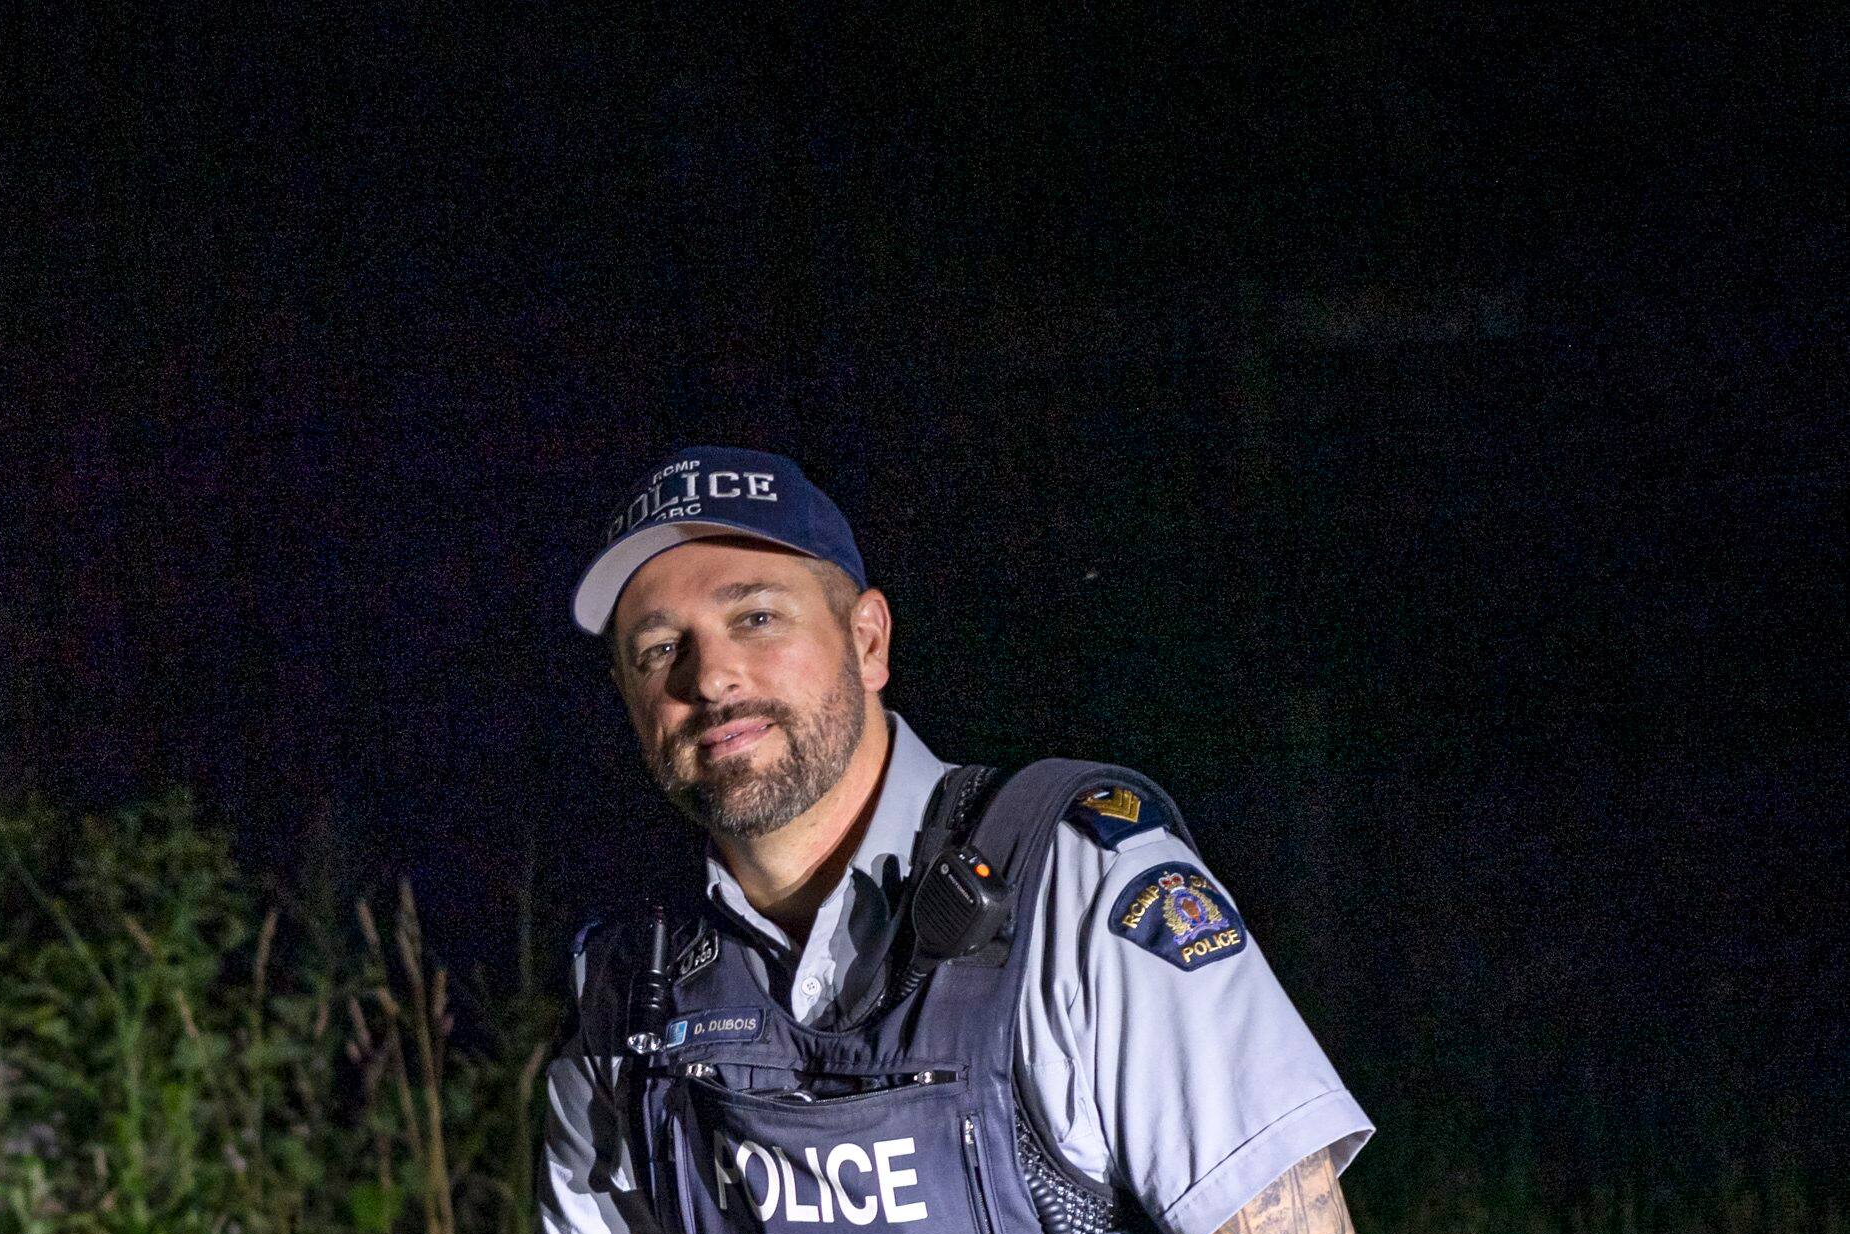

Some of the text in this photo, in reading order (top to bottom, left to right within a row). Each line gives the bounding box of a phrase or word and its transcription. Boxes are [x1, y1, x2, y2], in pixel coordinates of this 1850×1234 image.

[653, 460, 700, 485] RCMP
[607, 471, 778, 542] POLICE
[1122, 885, 1160, 929] RCMP
[1181, 929, 1241, 963] POLICE
[694, 1018, 757, 1035] D. DUBOIS
[713, 1130, 928, 1225] POLICE
